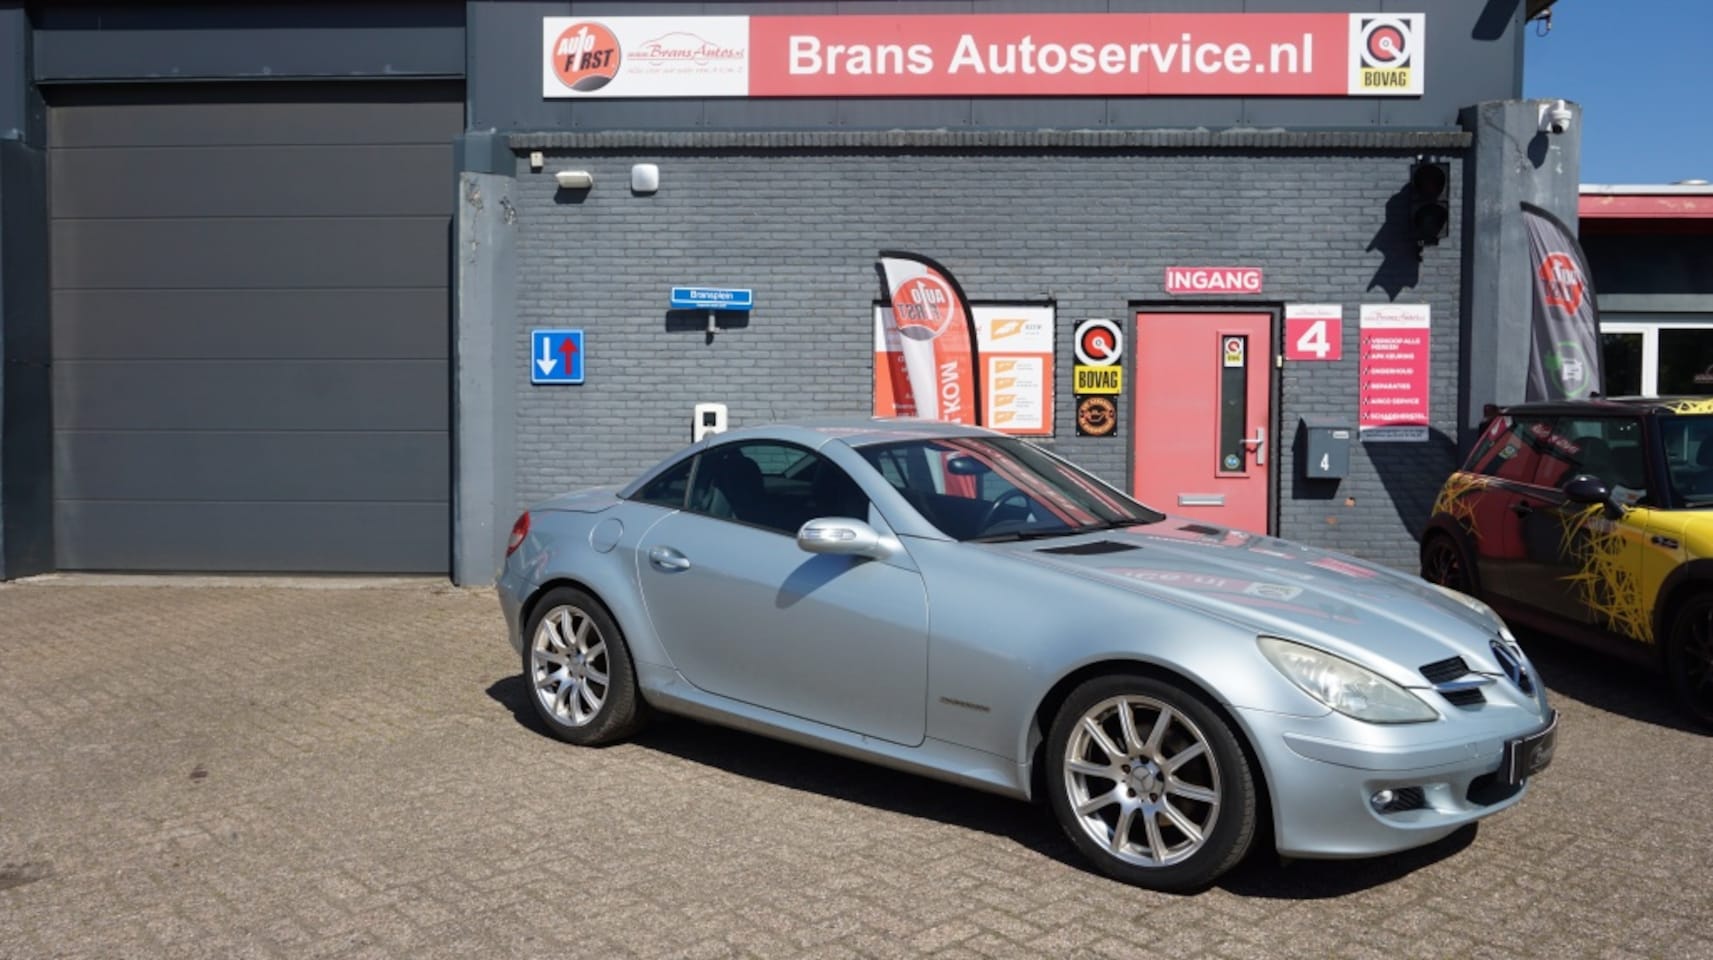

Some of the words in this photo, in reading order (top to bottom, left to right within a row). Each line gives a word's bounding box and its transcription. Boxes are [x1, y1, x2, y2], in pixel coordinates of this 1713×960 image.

[789, 35, 934, 75] Brans
[947, 33, 1313, 75] Autoservice.nl
[1364, 70, 1407, 87] BOVAG
[1168, 271, 1260, 289] INGANG
[1296, 320, 1331, 358] 4
[1078, 371, 1118, 389] BOVAG
[1320, 452, 1330, 471] 4
